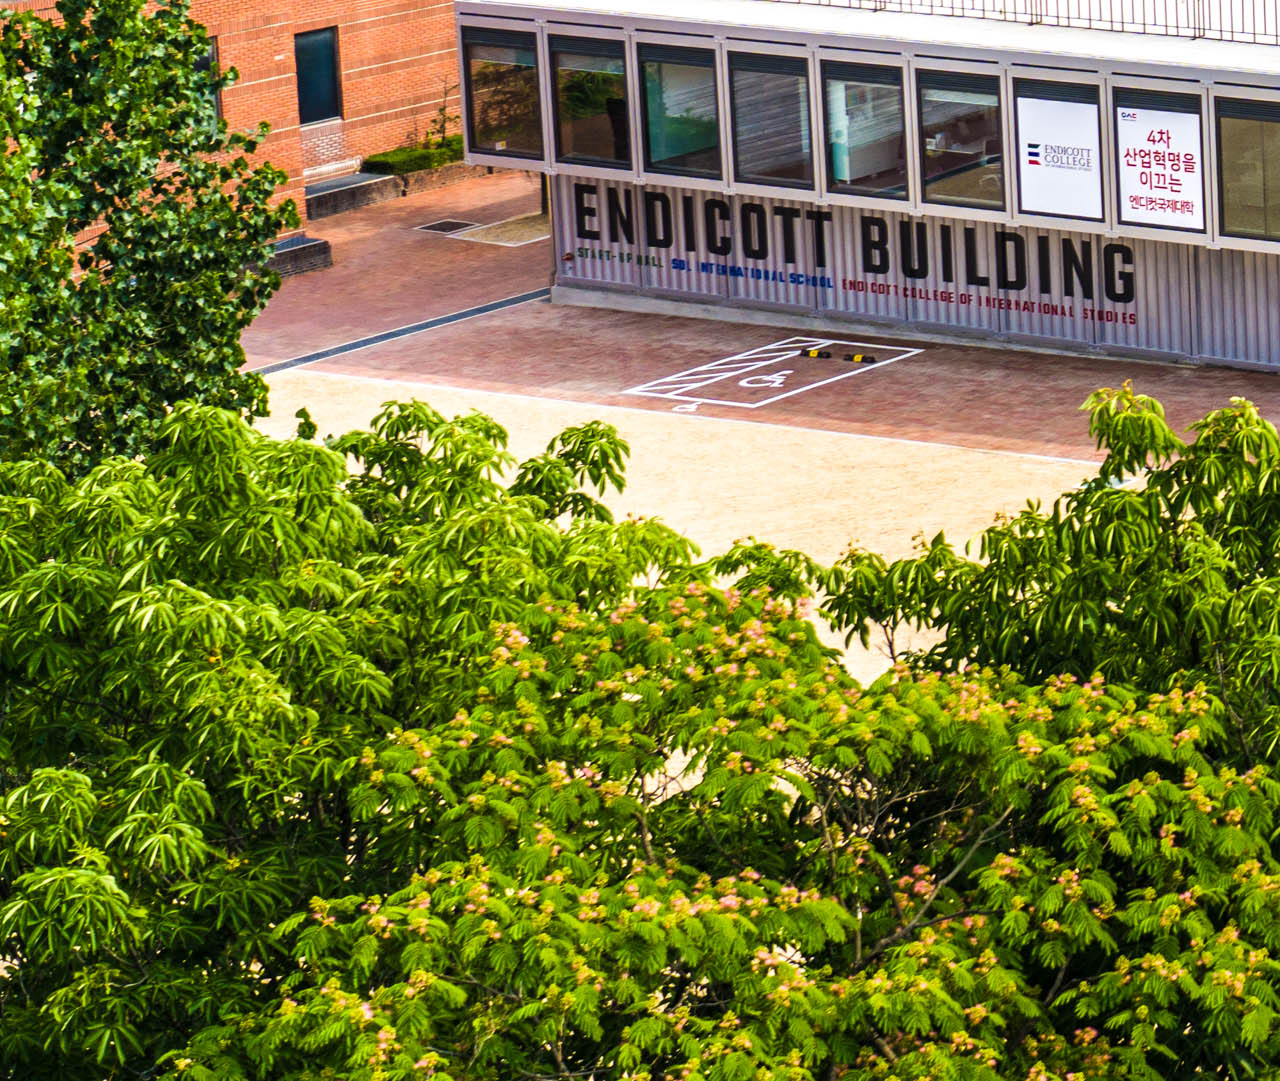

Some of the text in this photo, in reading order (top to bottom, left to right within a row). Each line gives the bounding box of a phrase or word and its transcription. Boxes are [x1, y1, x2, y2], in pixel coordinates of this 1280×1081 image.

[1147, 129, 1171, 149] 4차
[1044, 154, 1092, 168] COLLEGE
[1045, 144, 1092, 158] ENDICOTT
[1123, 148, 1196, 173] 산업혁명을
[1140, 171, 1182, 193] 이끄는
[1129, 195, 1194, 216] 엔디컷국제대학
[574, 183, 1135, 304] ENDICOTT BUILDING
[697, 262, 785, 283] INTERNATIONAL
[790, 272, 833, 288] SCHOOL
[842, 278, 1137, 325] ENDICOTT COLLEGE OF INTERNATIONAL STUDIES
